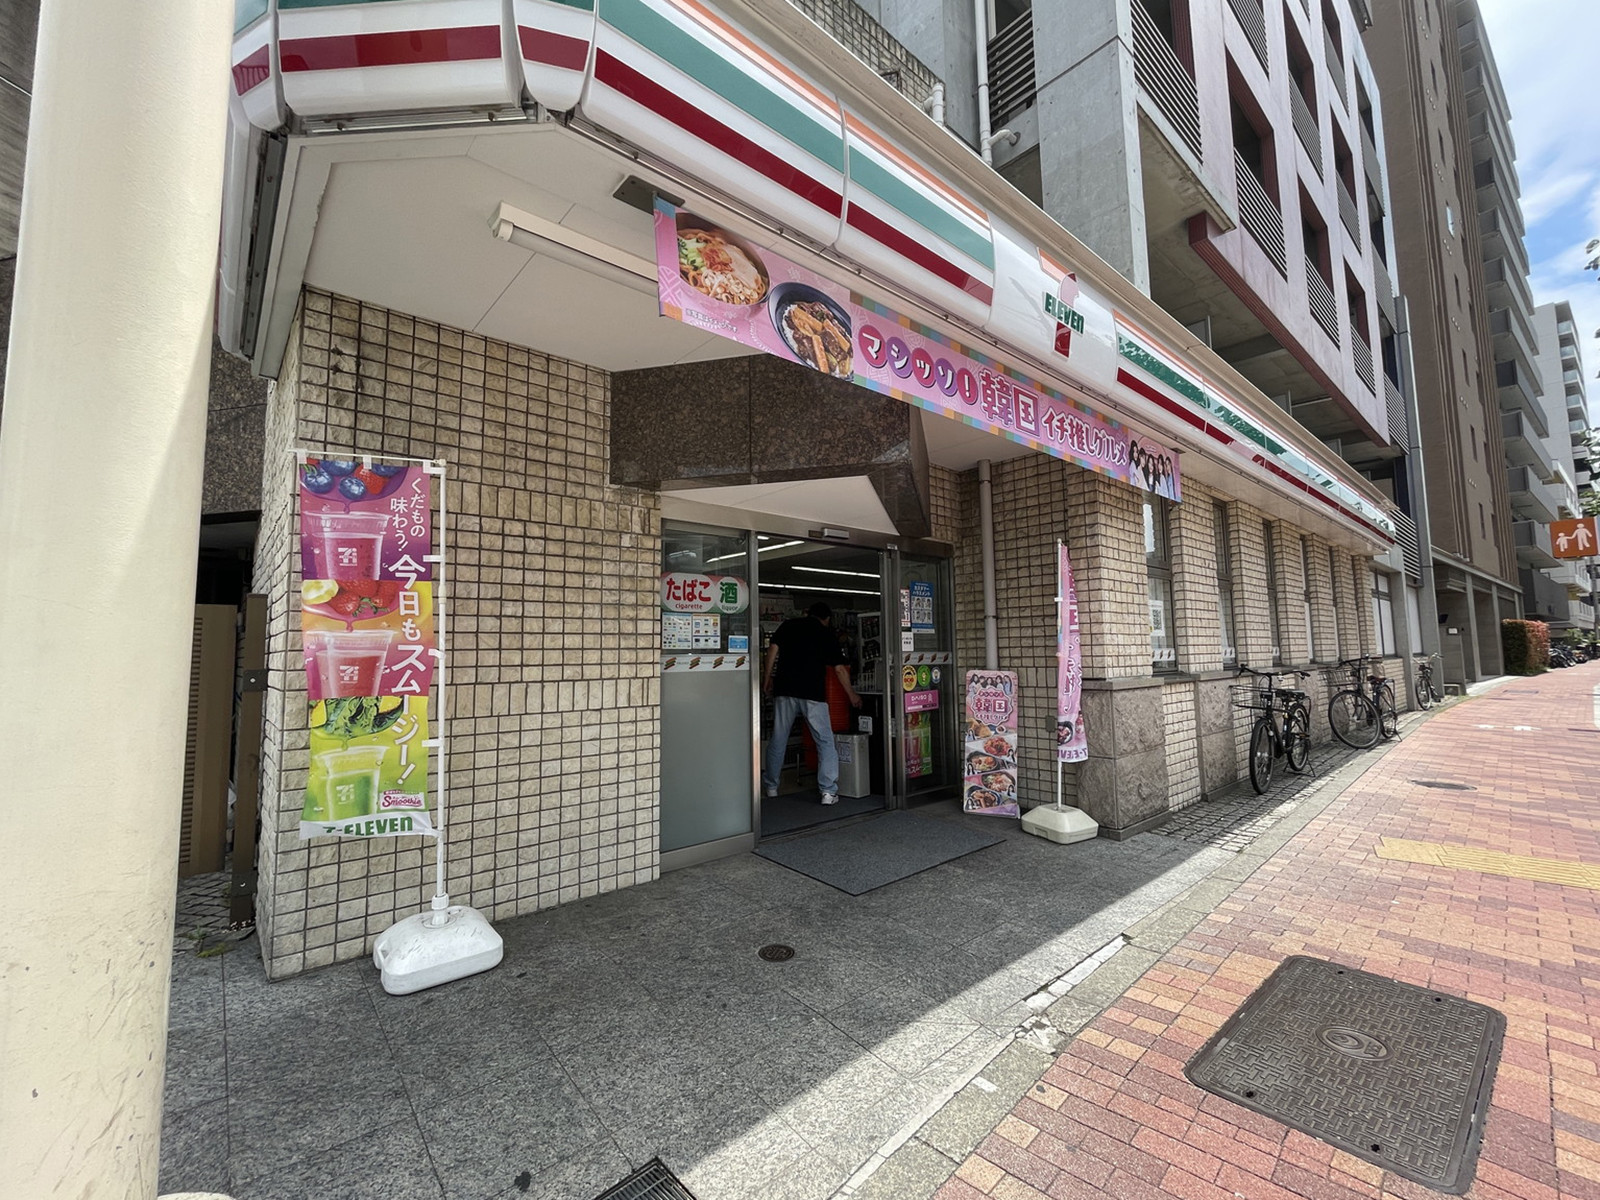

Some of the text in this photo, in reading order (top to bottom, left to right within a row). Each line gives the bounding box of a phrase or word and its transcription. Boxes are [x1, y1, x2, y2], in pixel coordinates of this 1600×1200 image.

[979, 369, 1040, 438] 韓国
[1041, 406, 1128, 466] イチ推しグルメ
[409, 477, 426, 538] くだもの
[666, 577, 738, 604] たばこ 酒
[675, 602, 739, 611] cigarette liquor
[975, 698, 1008, 713] 韓国
[382, 795, 422, 808] Smoothie
